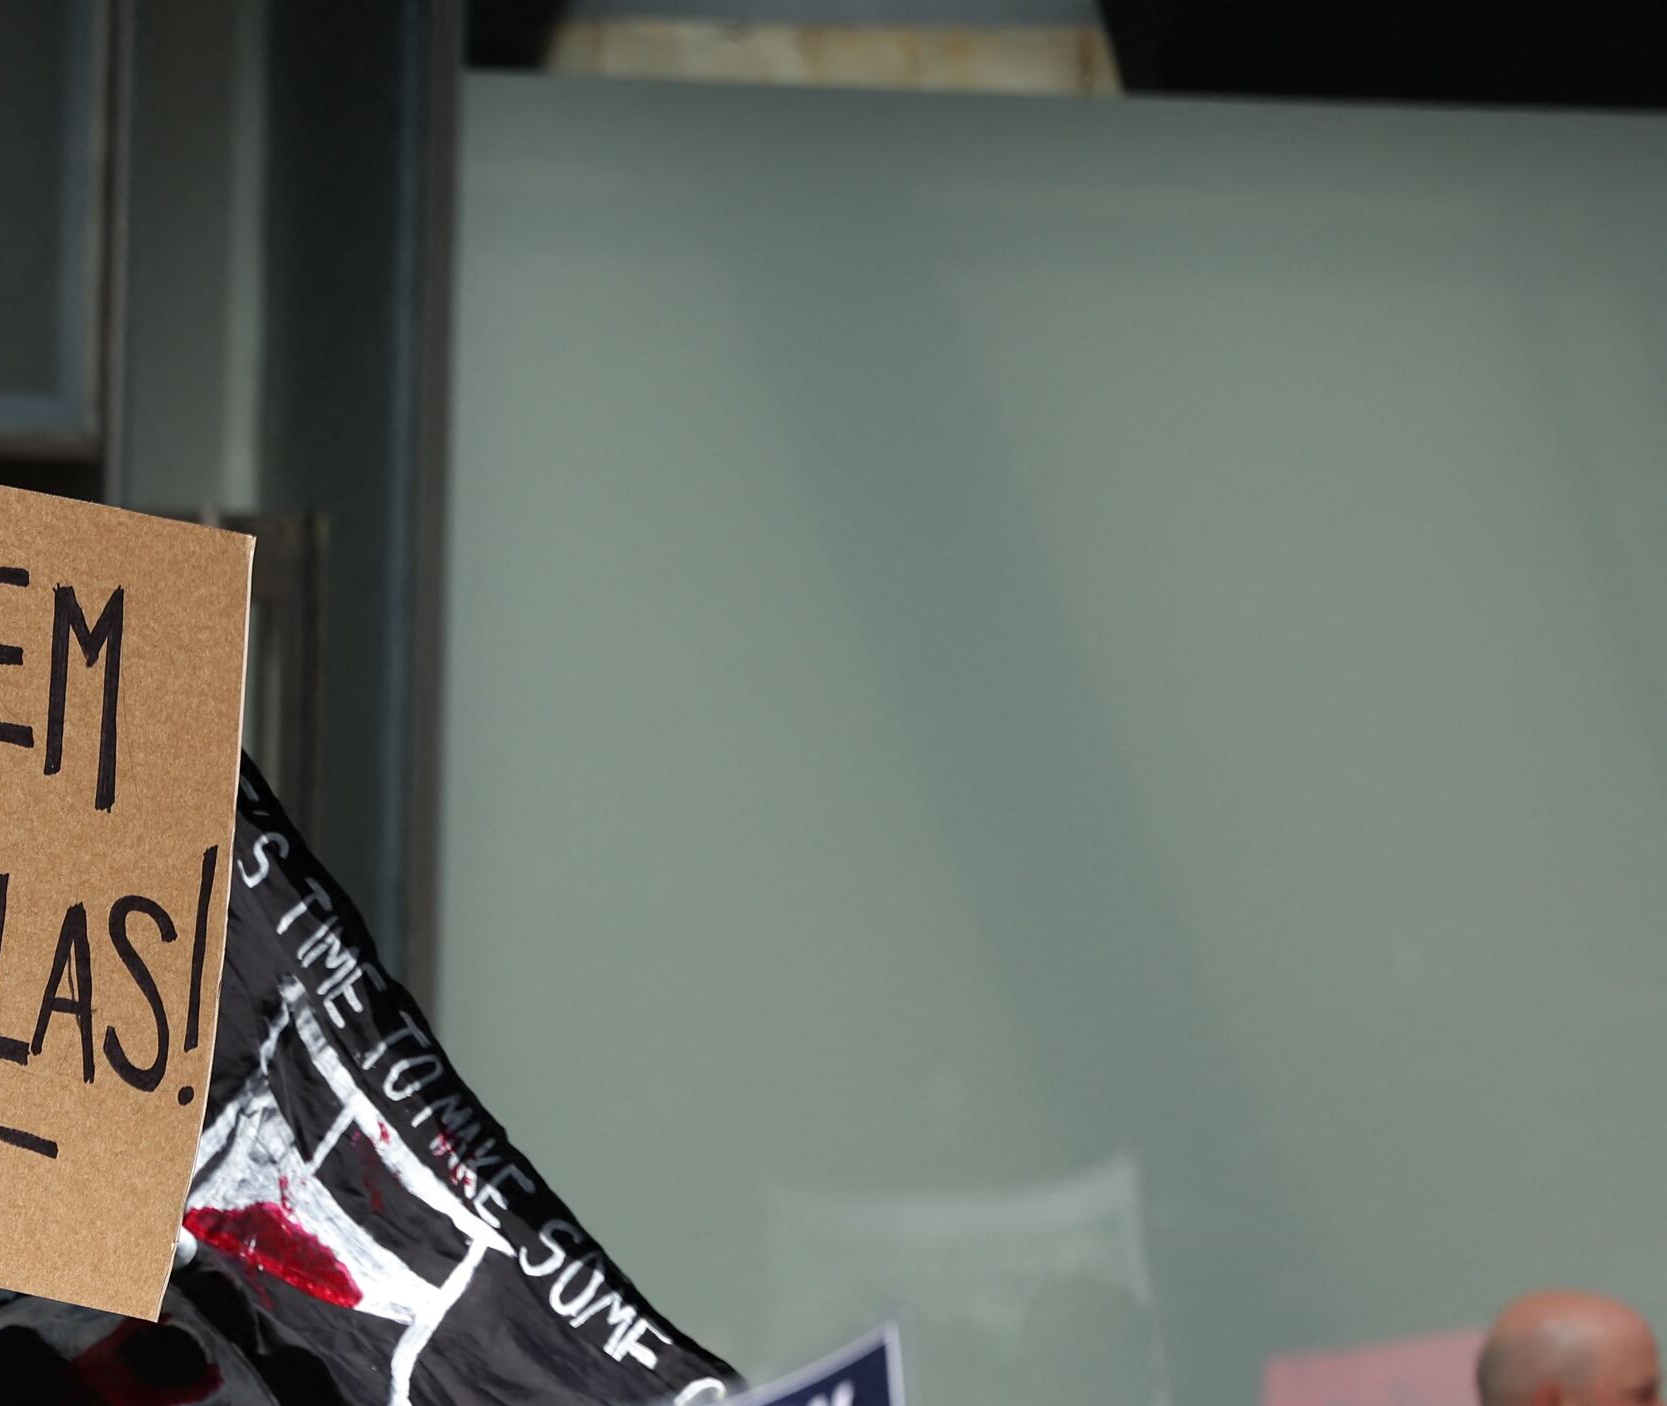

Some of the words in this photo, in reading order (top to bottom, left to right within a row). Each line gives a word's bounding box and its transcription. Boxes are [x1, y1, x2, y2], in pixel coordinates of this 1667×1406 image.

[275, 876, 388, 1030] TIME
[362, 1009, 444, 1102] TO
[410, 1094, 537, 1229] MAKE
[518, 1218, 674, 1372] SOME
